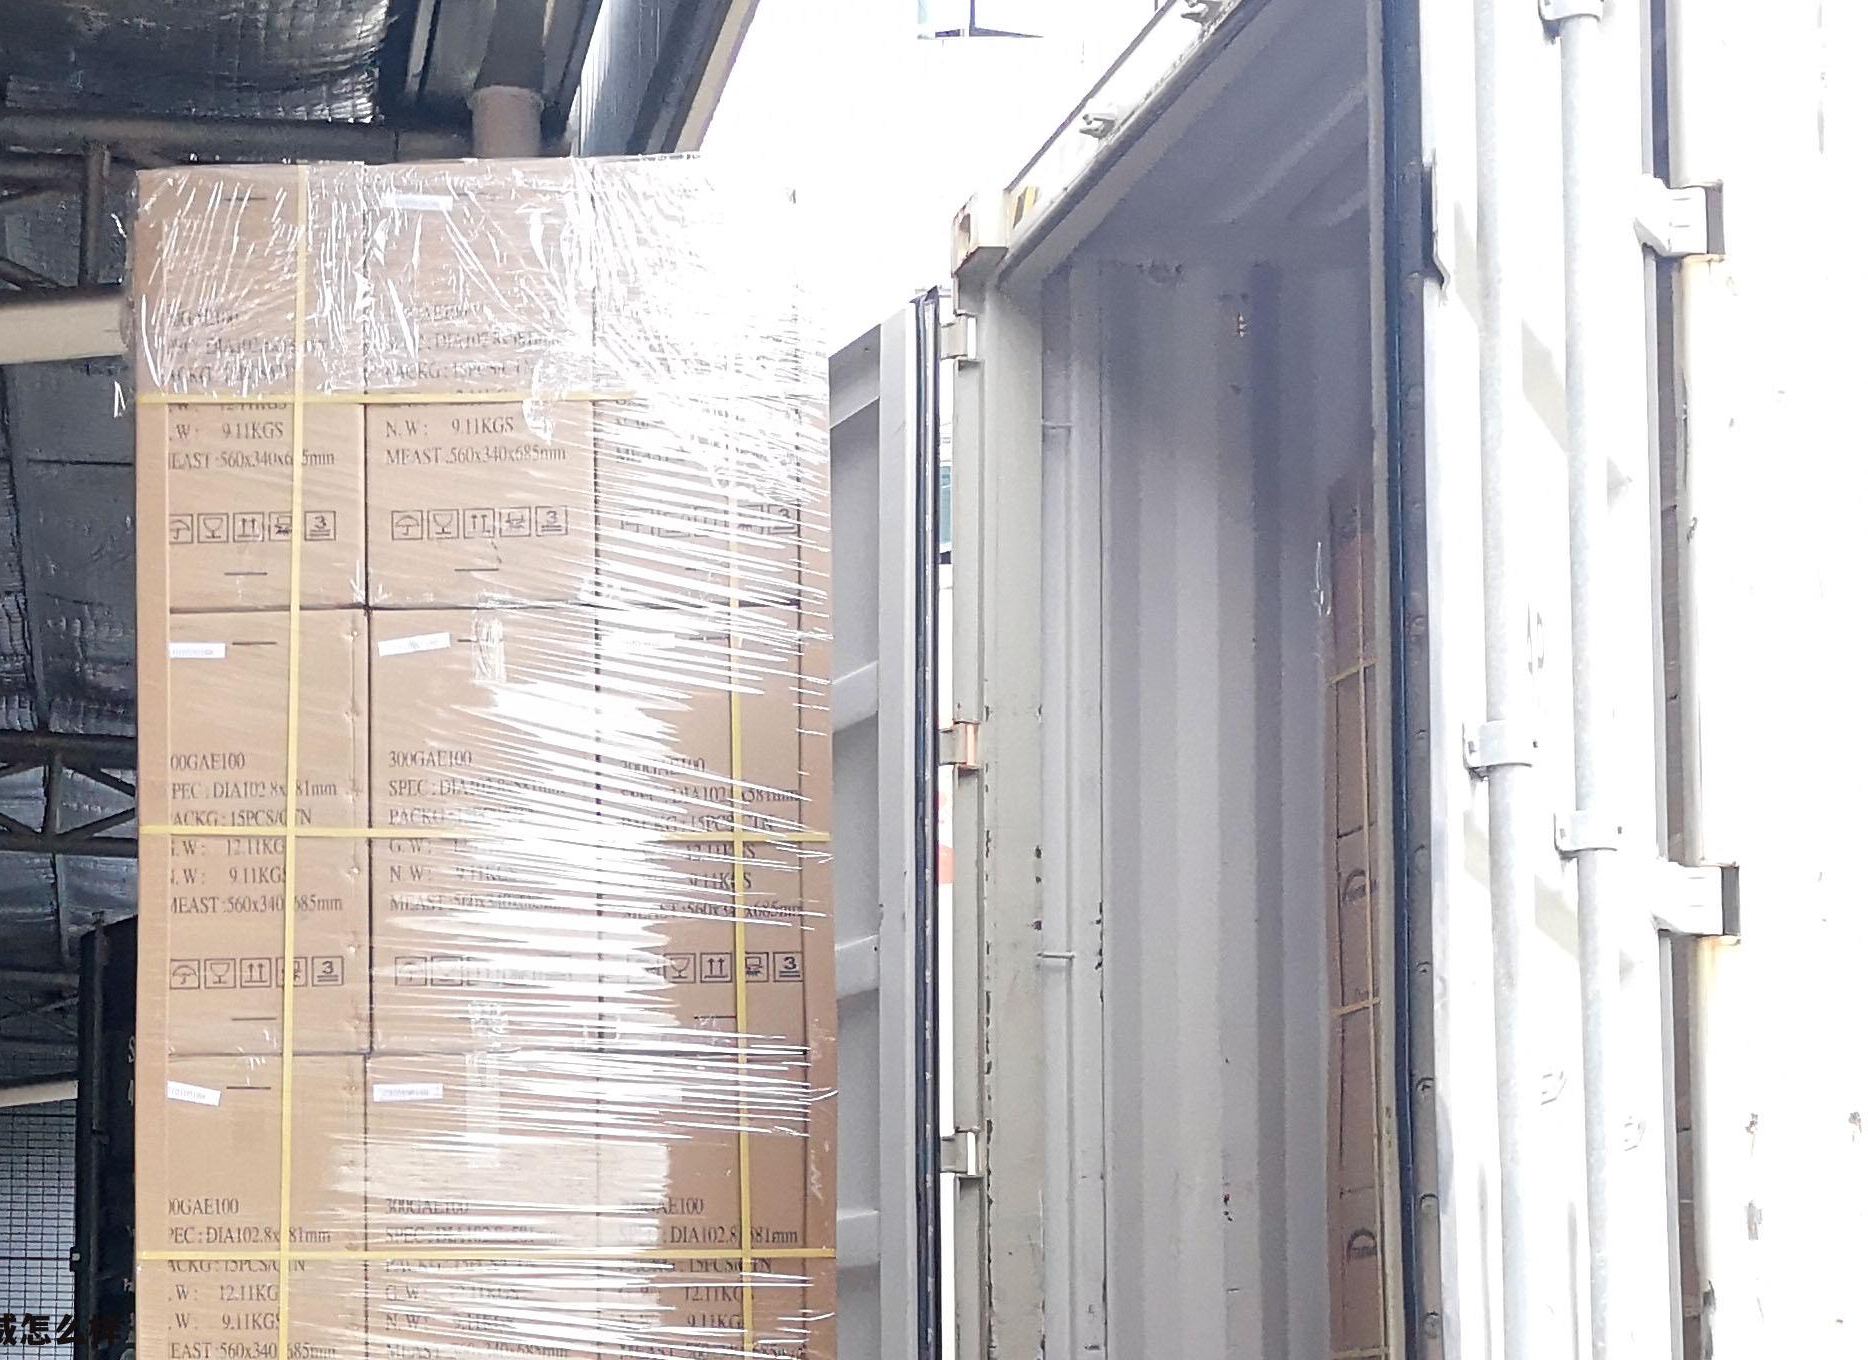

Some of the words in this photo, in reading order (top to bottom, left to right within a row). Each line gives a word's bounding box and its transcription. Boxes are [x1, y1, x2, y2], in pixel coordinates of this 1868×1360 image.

[213, 779, 337, 799] DIA102.8x81mm
[226, 838, 285, 856] 12.11KG
[206, 1226, 332, 1244] DIA102.8x81mm
[220, 1284, 279, 1302] 12.11KG
